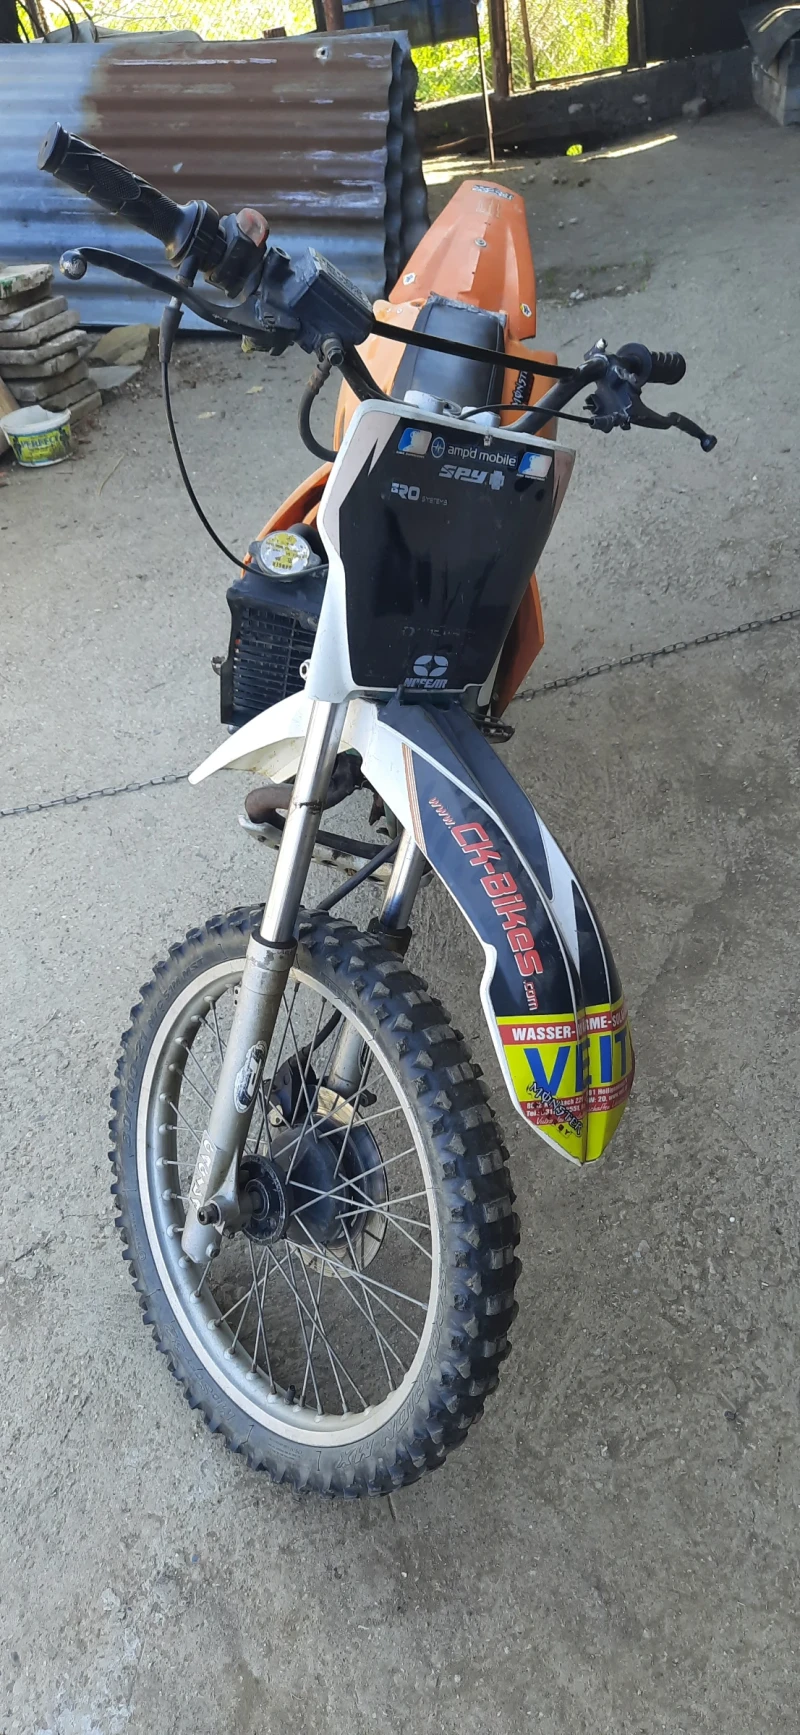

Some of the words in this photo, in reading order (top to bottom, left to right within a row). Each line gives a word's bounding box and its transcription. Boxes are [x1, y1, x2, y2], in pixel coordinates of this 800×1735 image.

[447, 445, 478, 460] amp'd
[479, 450, 517, 467] mobile
[512, 1026, 576, 1042] WASSER-
[524, 1031, 628, 1097] VEIT
